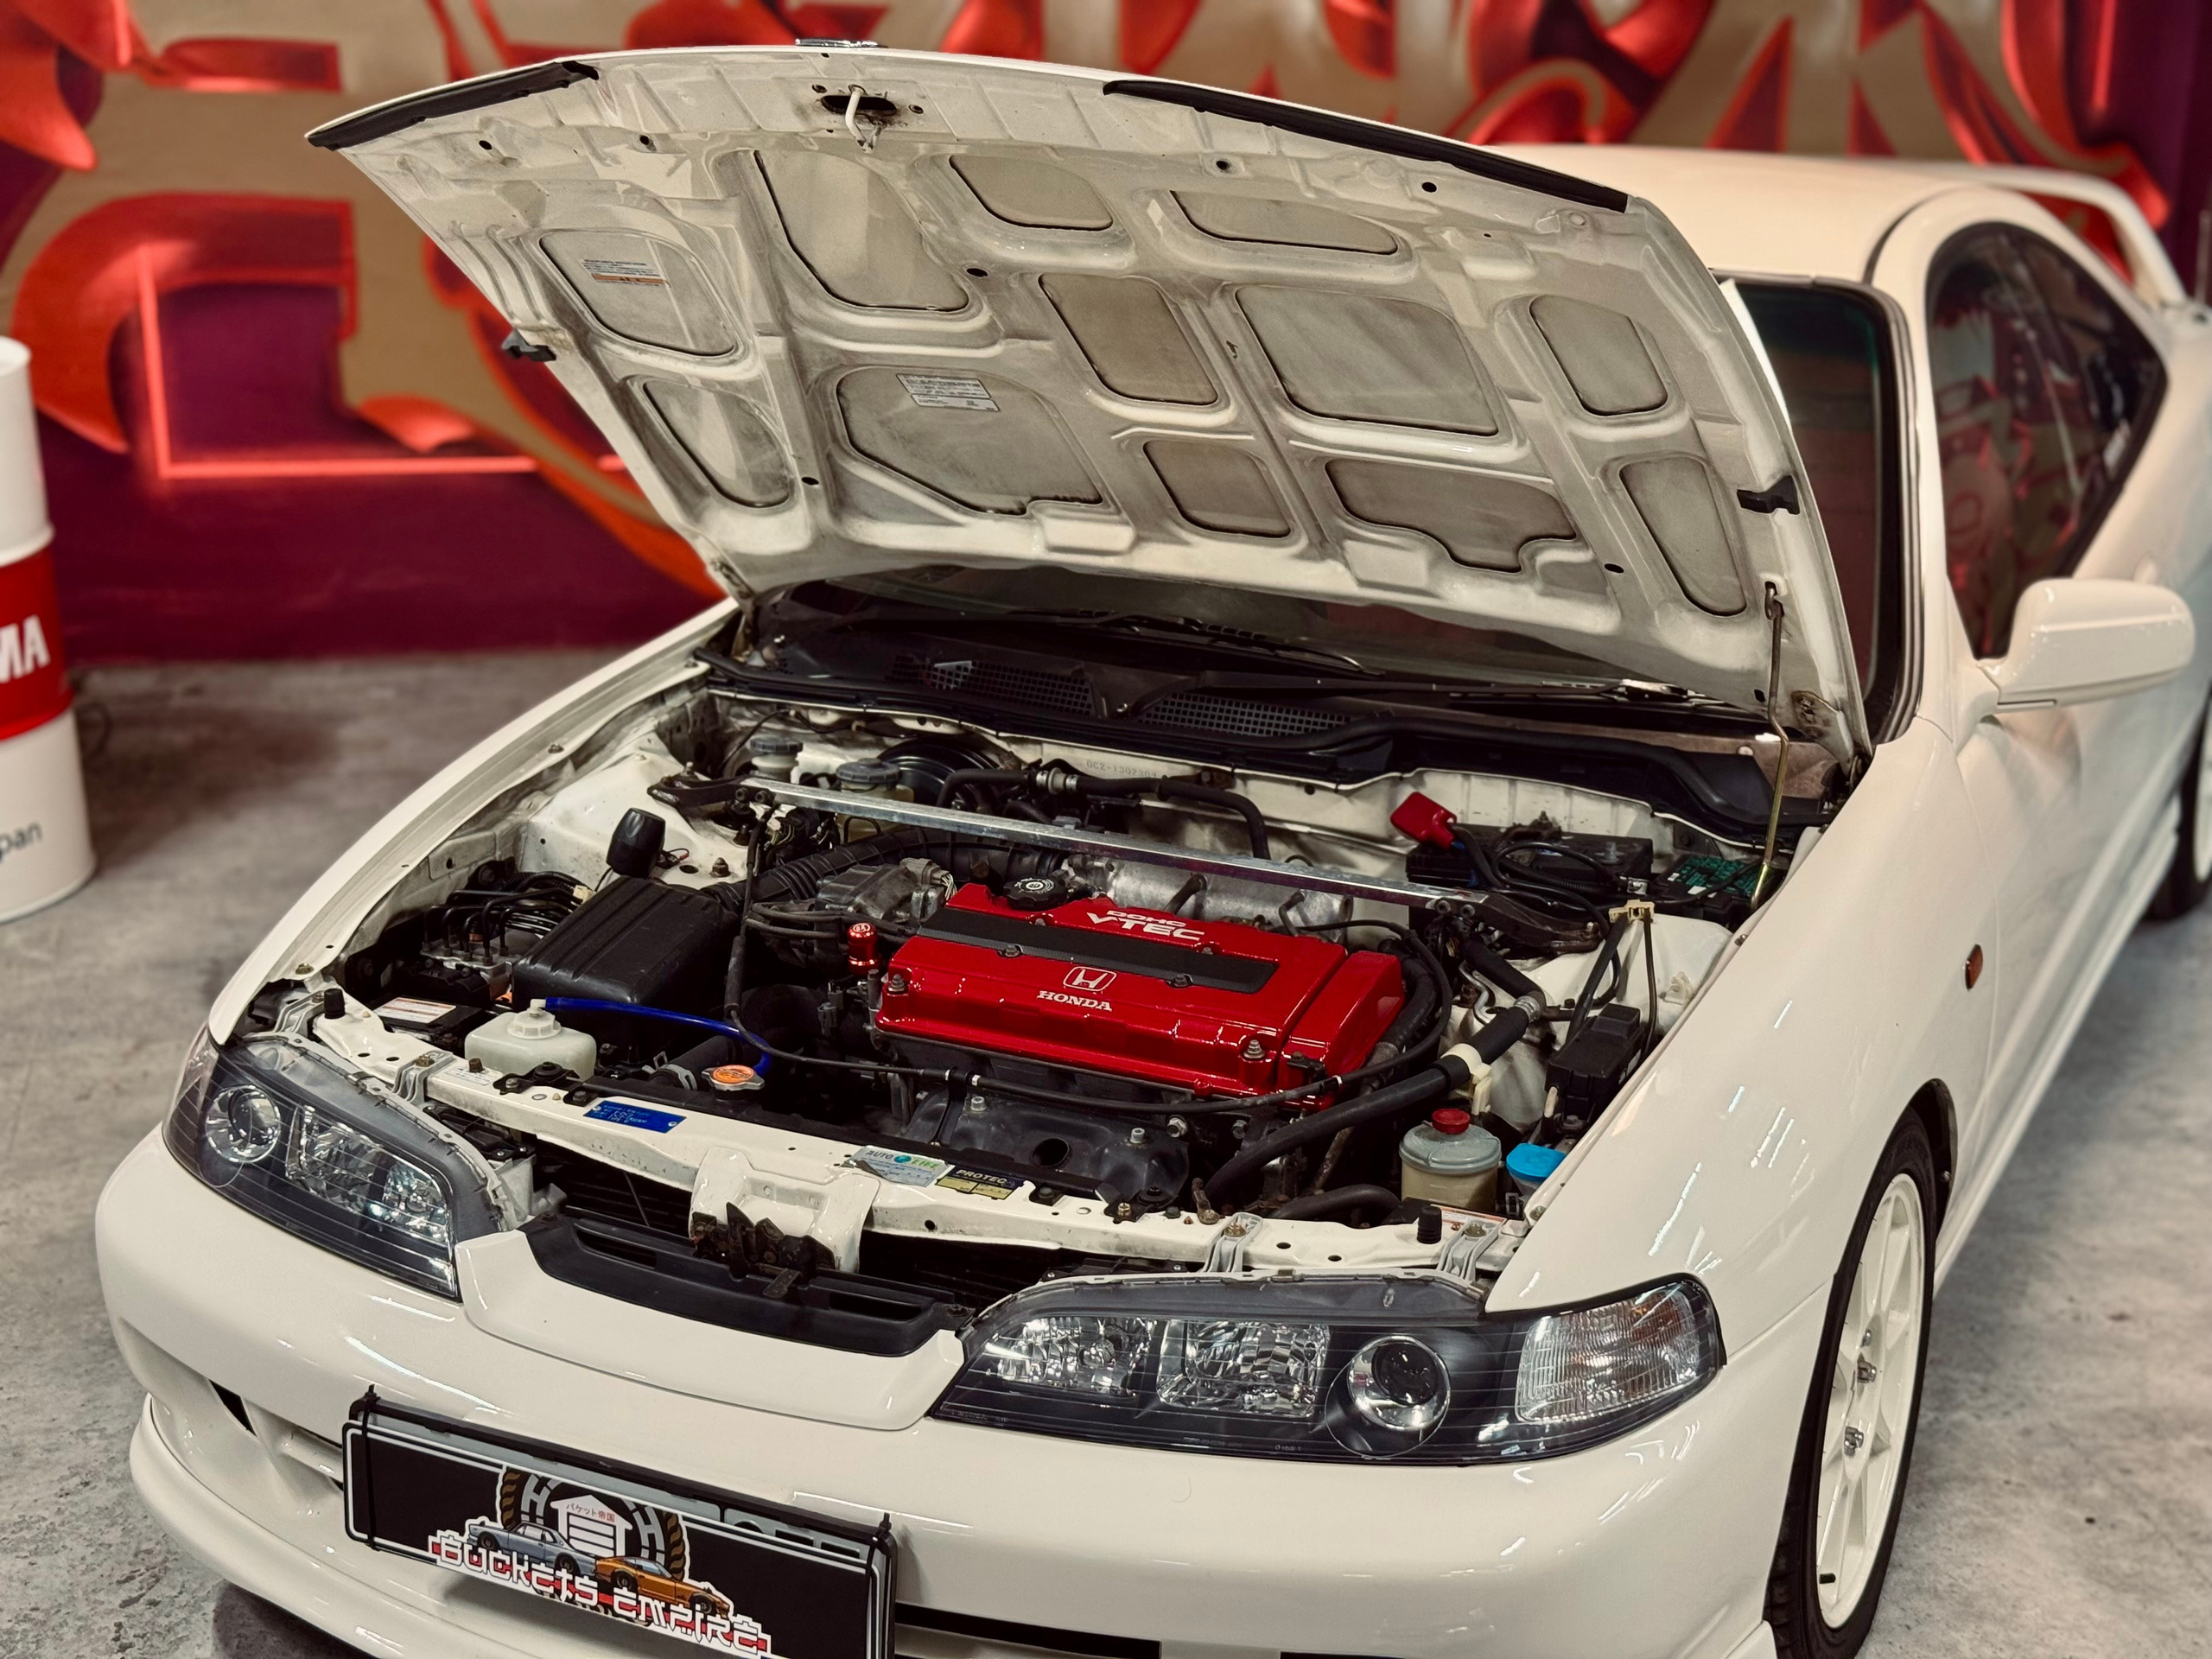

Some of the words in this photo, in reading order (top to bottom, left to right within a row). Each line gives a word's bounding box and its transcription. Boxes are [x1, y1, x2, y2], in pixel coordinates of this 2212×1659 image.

[1086, 912, 1205, 941] VTEC
[1107, 910, 1186, 927] DOHC
[1037, 990, 1112, 1012] HONDA
[866, 1150, 893, 1160] AUTO
[440, 1534, 598, 1607] BUCKETS
[613, 1586, 759, 1653] EMPIRE
